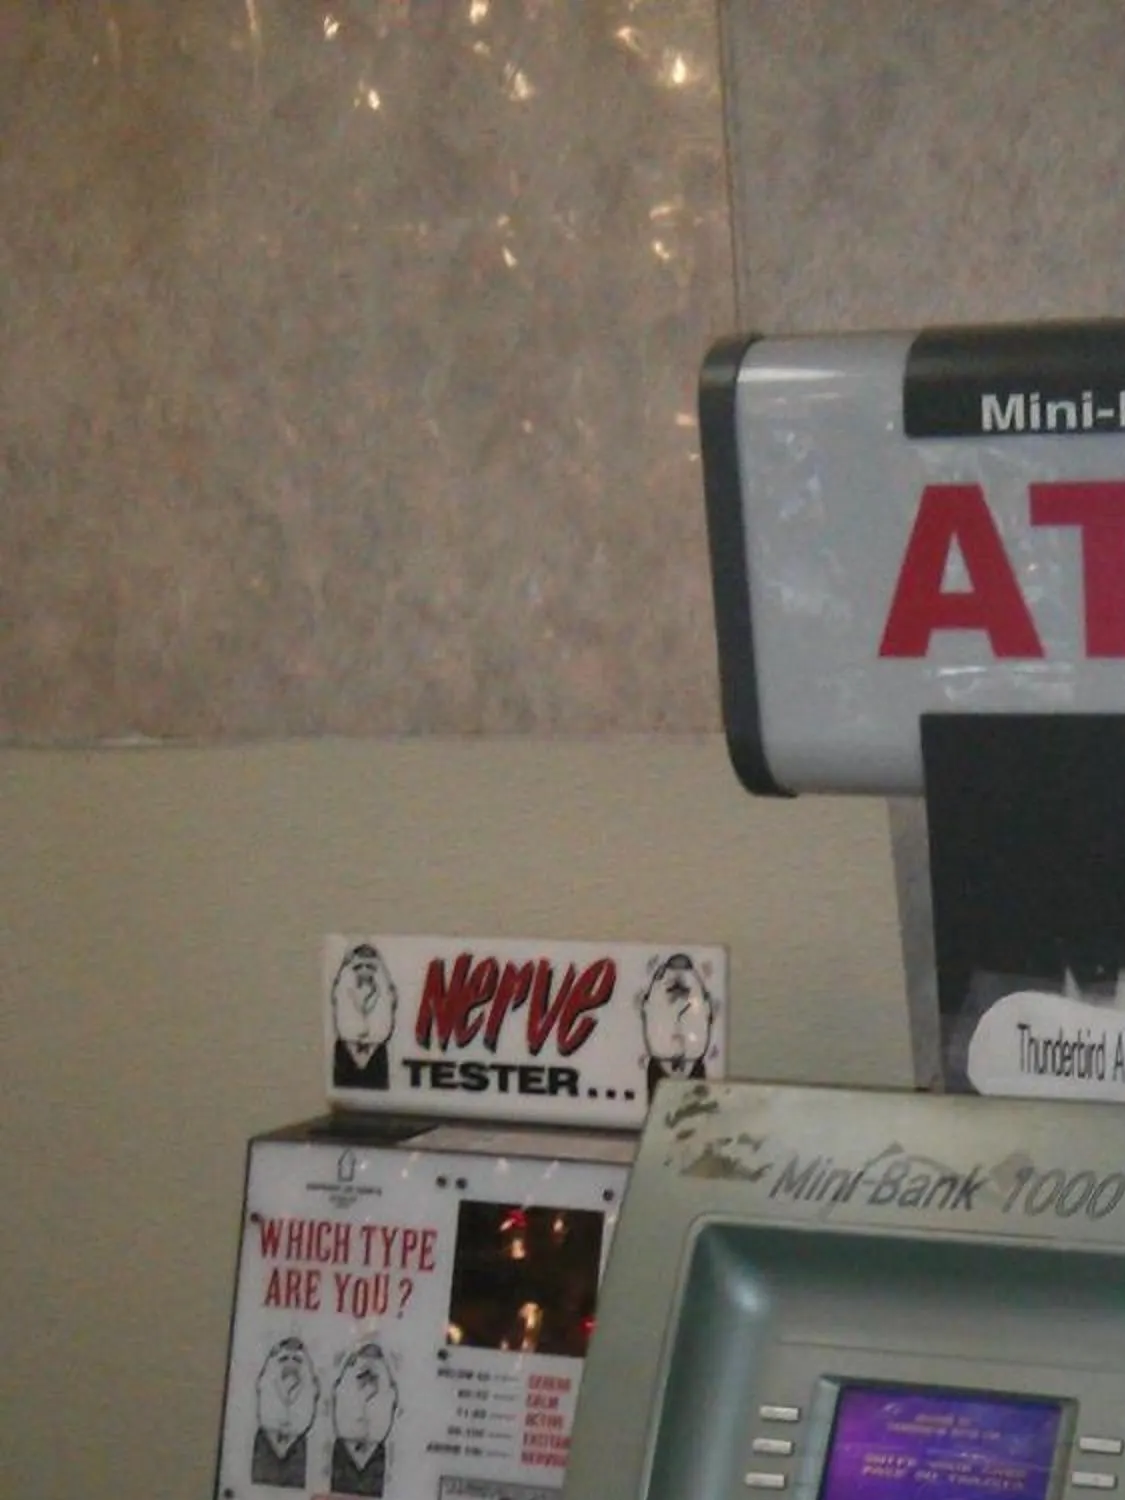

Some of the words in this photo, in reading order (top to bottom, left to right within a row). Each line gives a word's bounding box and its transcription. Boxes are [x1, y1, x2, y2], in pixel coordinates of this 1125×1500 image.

[415, 952, 617, 1058] Nerve
[1017, 1023, 1106, 1081] Thunderbird
[769, 1152, 986, 1212] Mini-Bank
[260, 1218, 353, 1265] WHICH
[361, 1224, 438, 1272] TYPE
[264, 1267, 321, 1312] ARE
